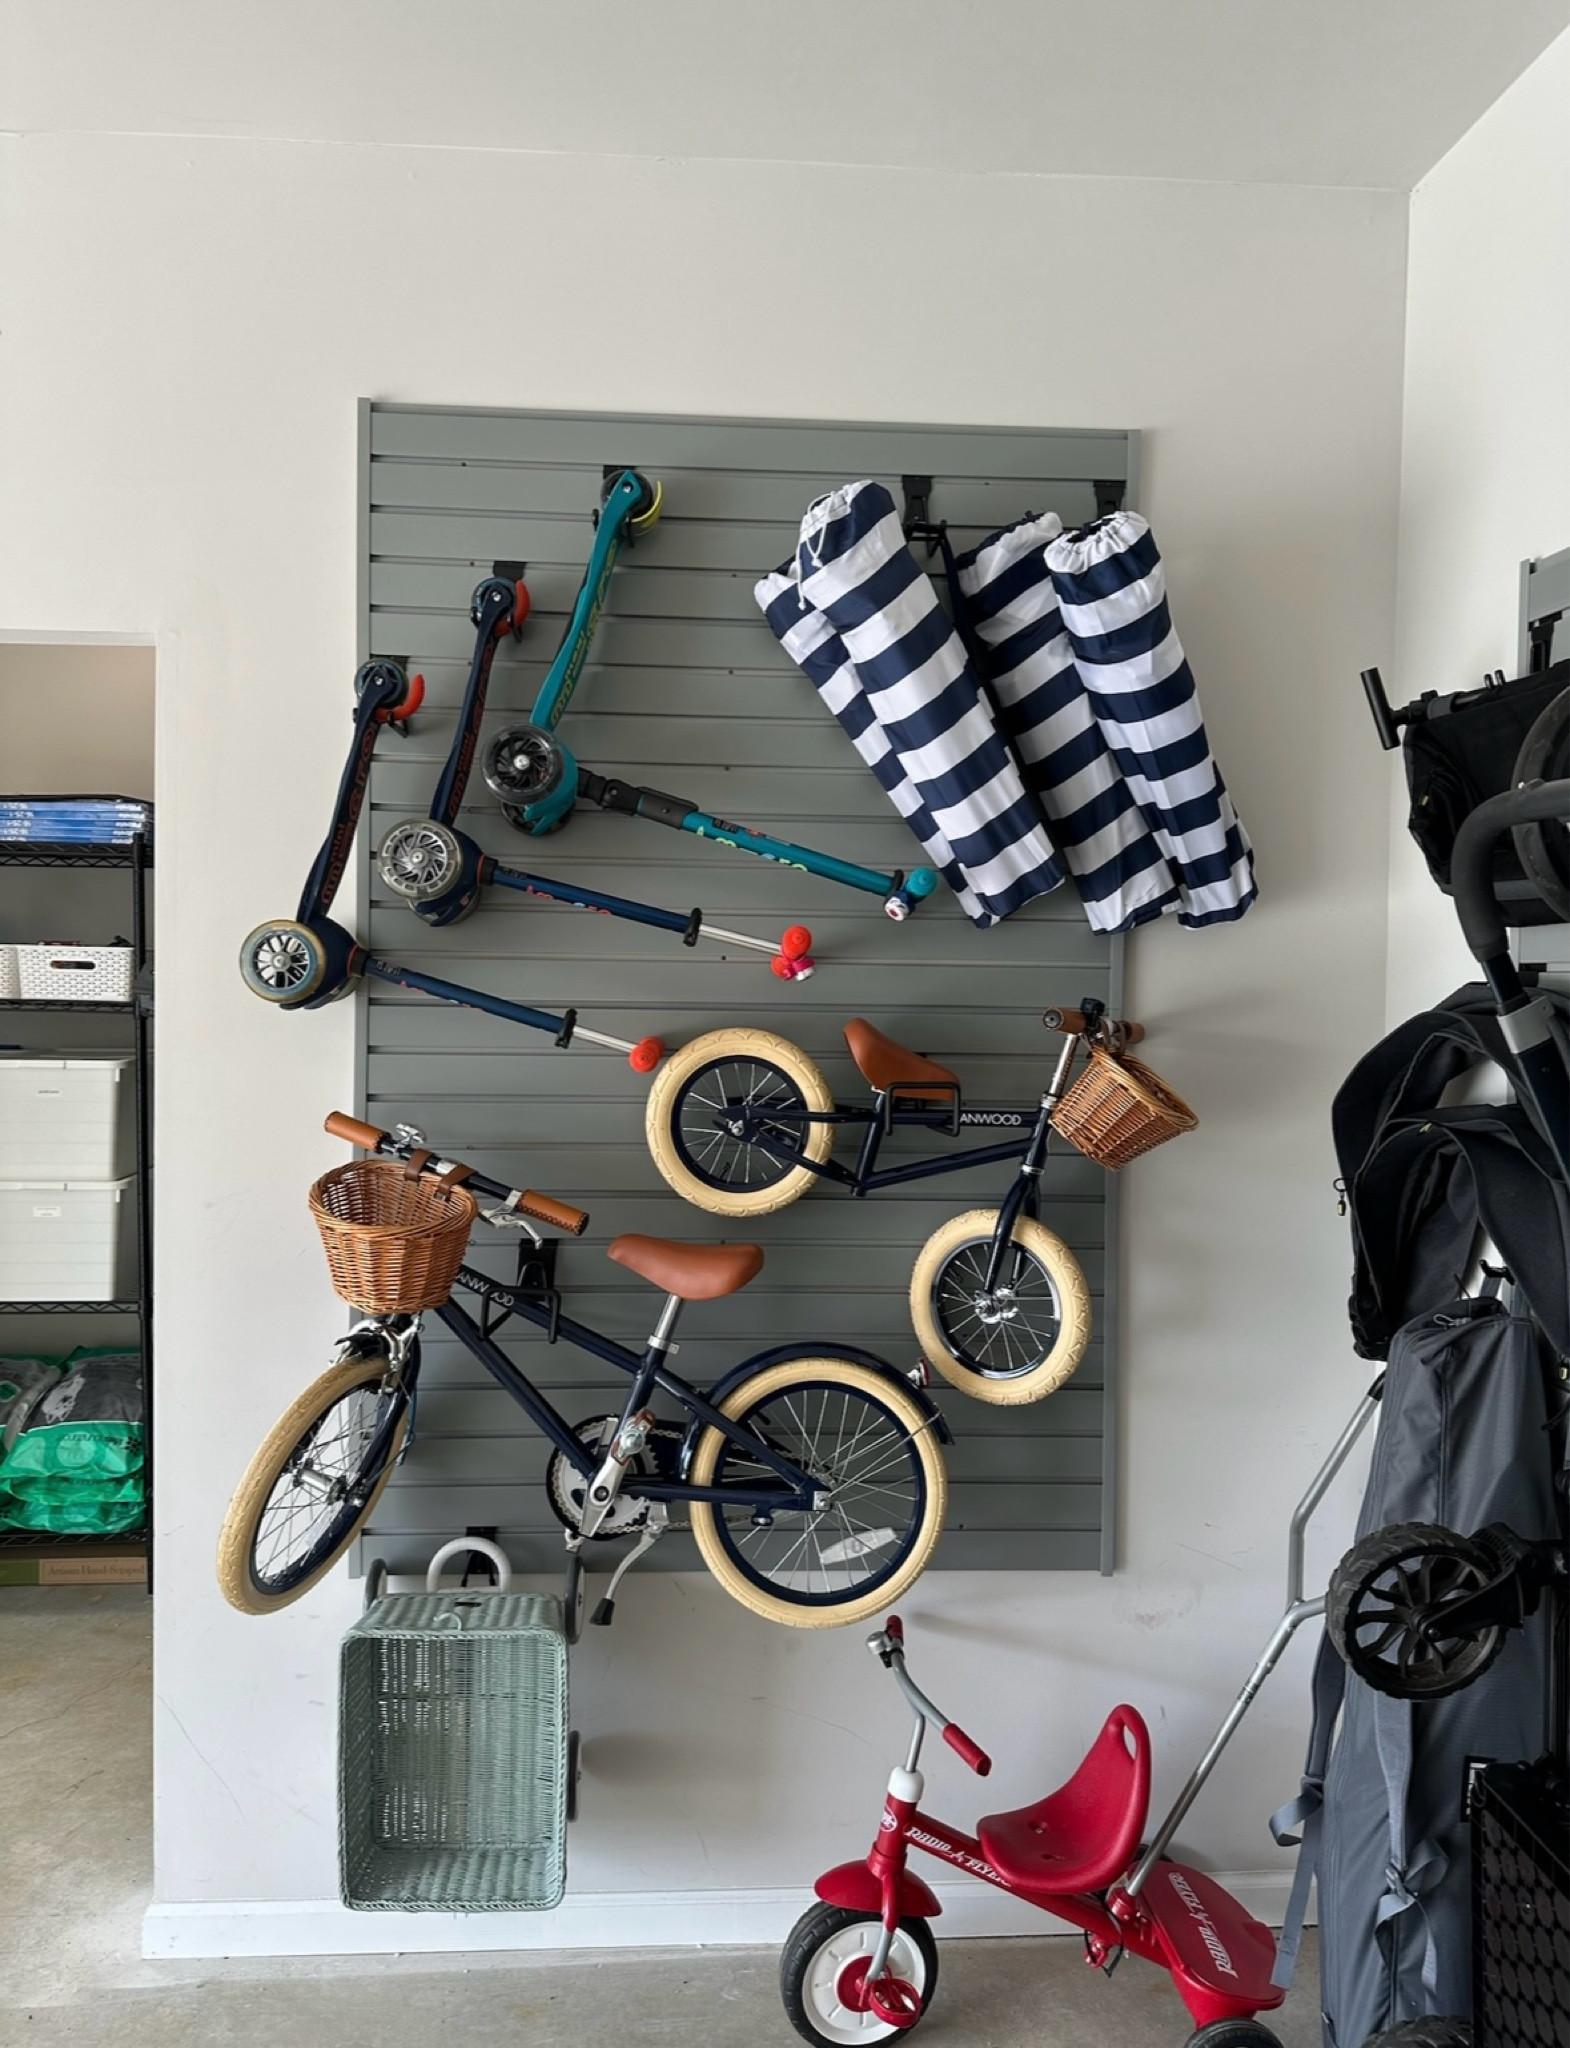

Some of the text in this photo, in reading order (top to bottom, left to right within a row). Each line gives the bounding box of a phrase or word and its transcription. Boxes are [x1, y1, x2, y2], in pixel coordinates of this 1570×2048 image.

[959, 1113, 1022, 1126] ANWOOD
[455, 1271, 515, 1307] ANWOD
[904, 1826, 956, 1858] RADIO
[1167, 1871, 1238, 1979] RADIO FLYER
